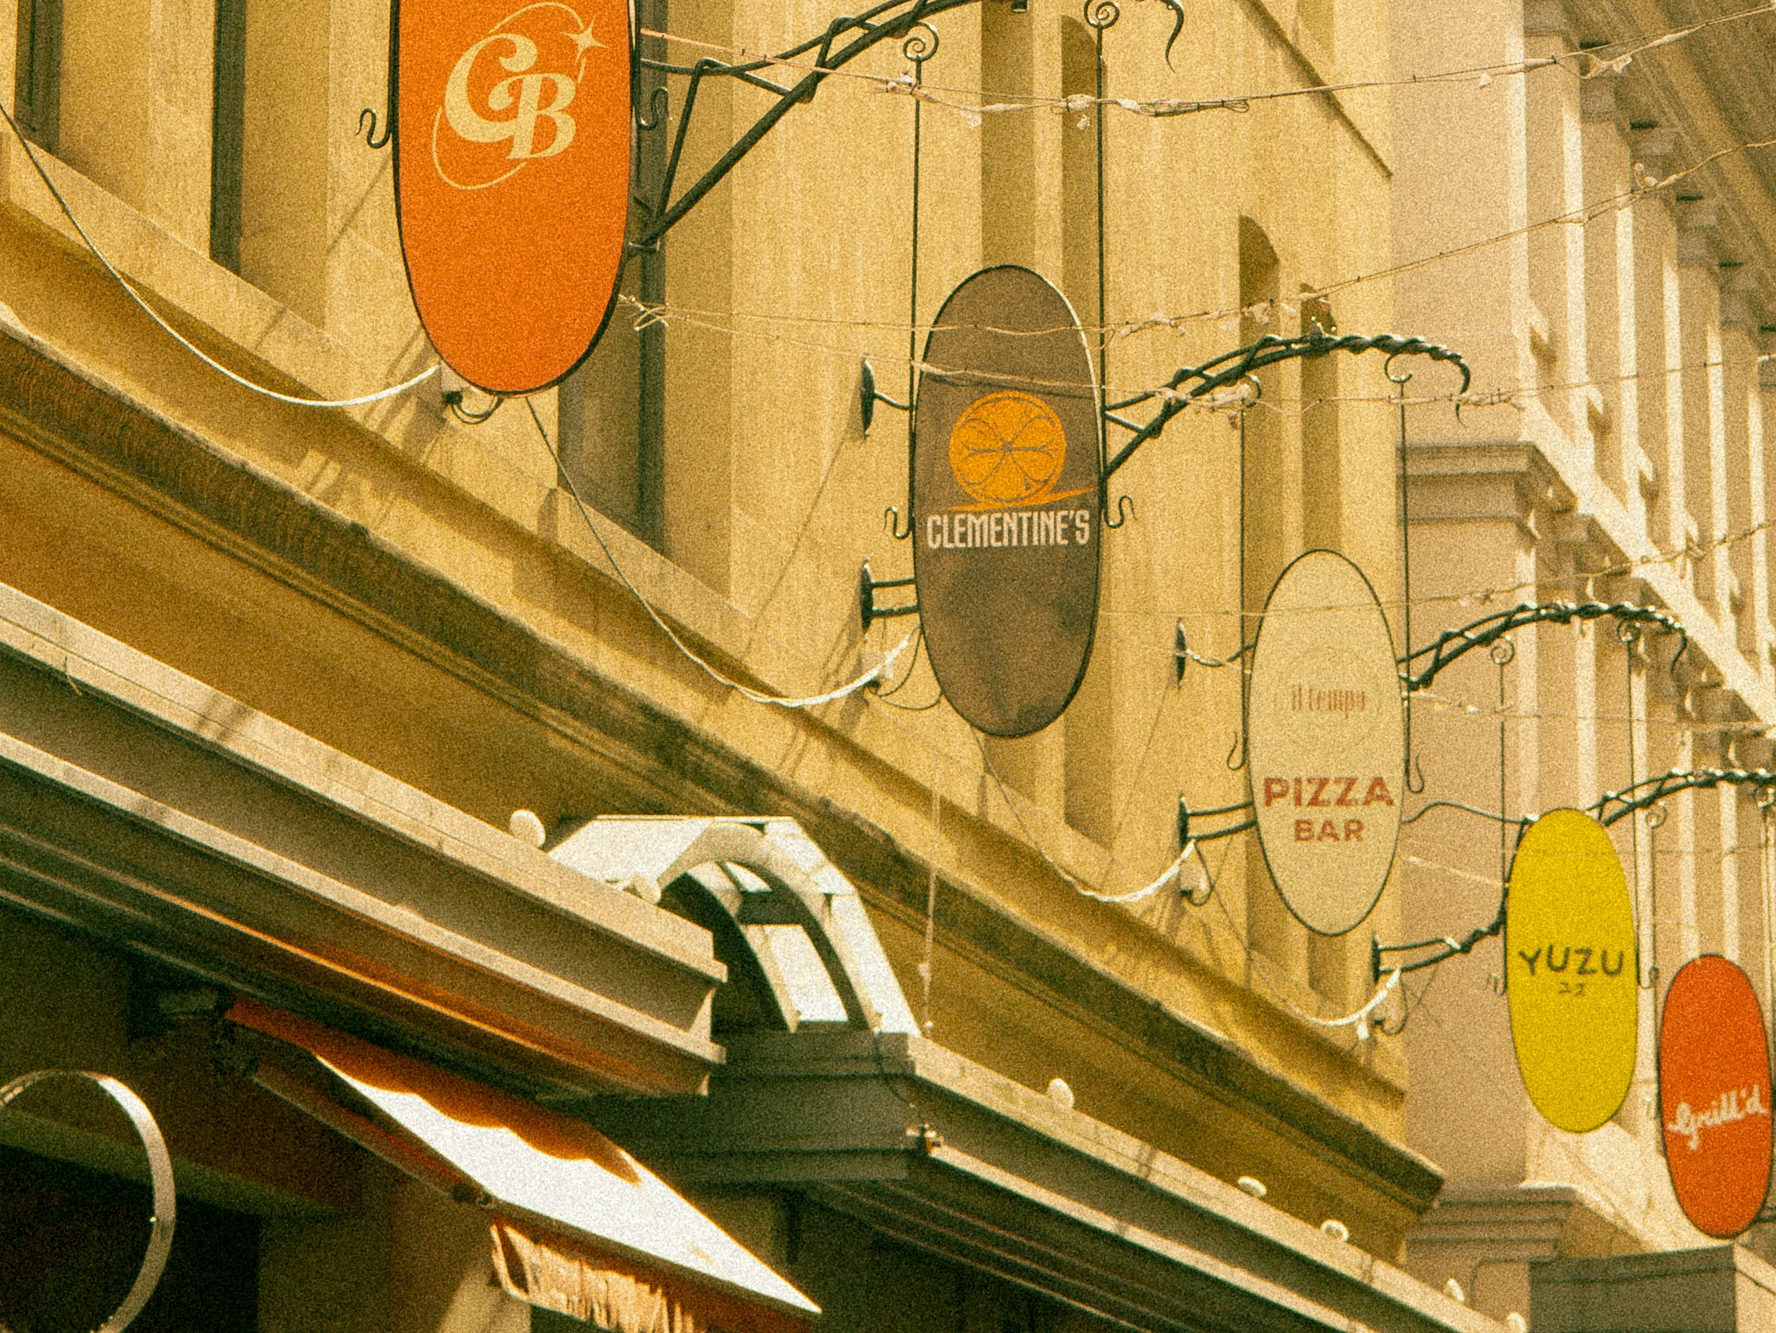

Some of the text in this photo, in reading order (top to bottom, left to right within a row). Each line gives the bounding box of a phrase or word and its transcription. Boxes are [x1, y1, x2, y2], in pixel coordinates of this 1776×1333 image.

[925, 509, 1091, 551] CLEMENTINE'S
[1263, 776, 1395, 807] PIZZA
[1293, 818, 1365, 843] BAR
[1518, 944, 1625, 977] YUZU
[1667, 1083, 1769, 1150] Grill'd
